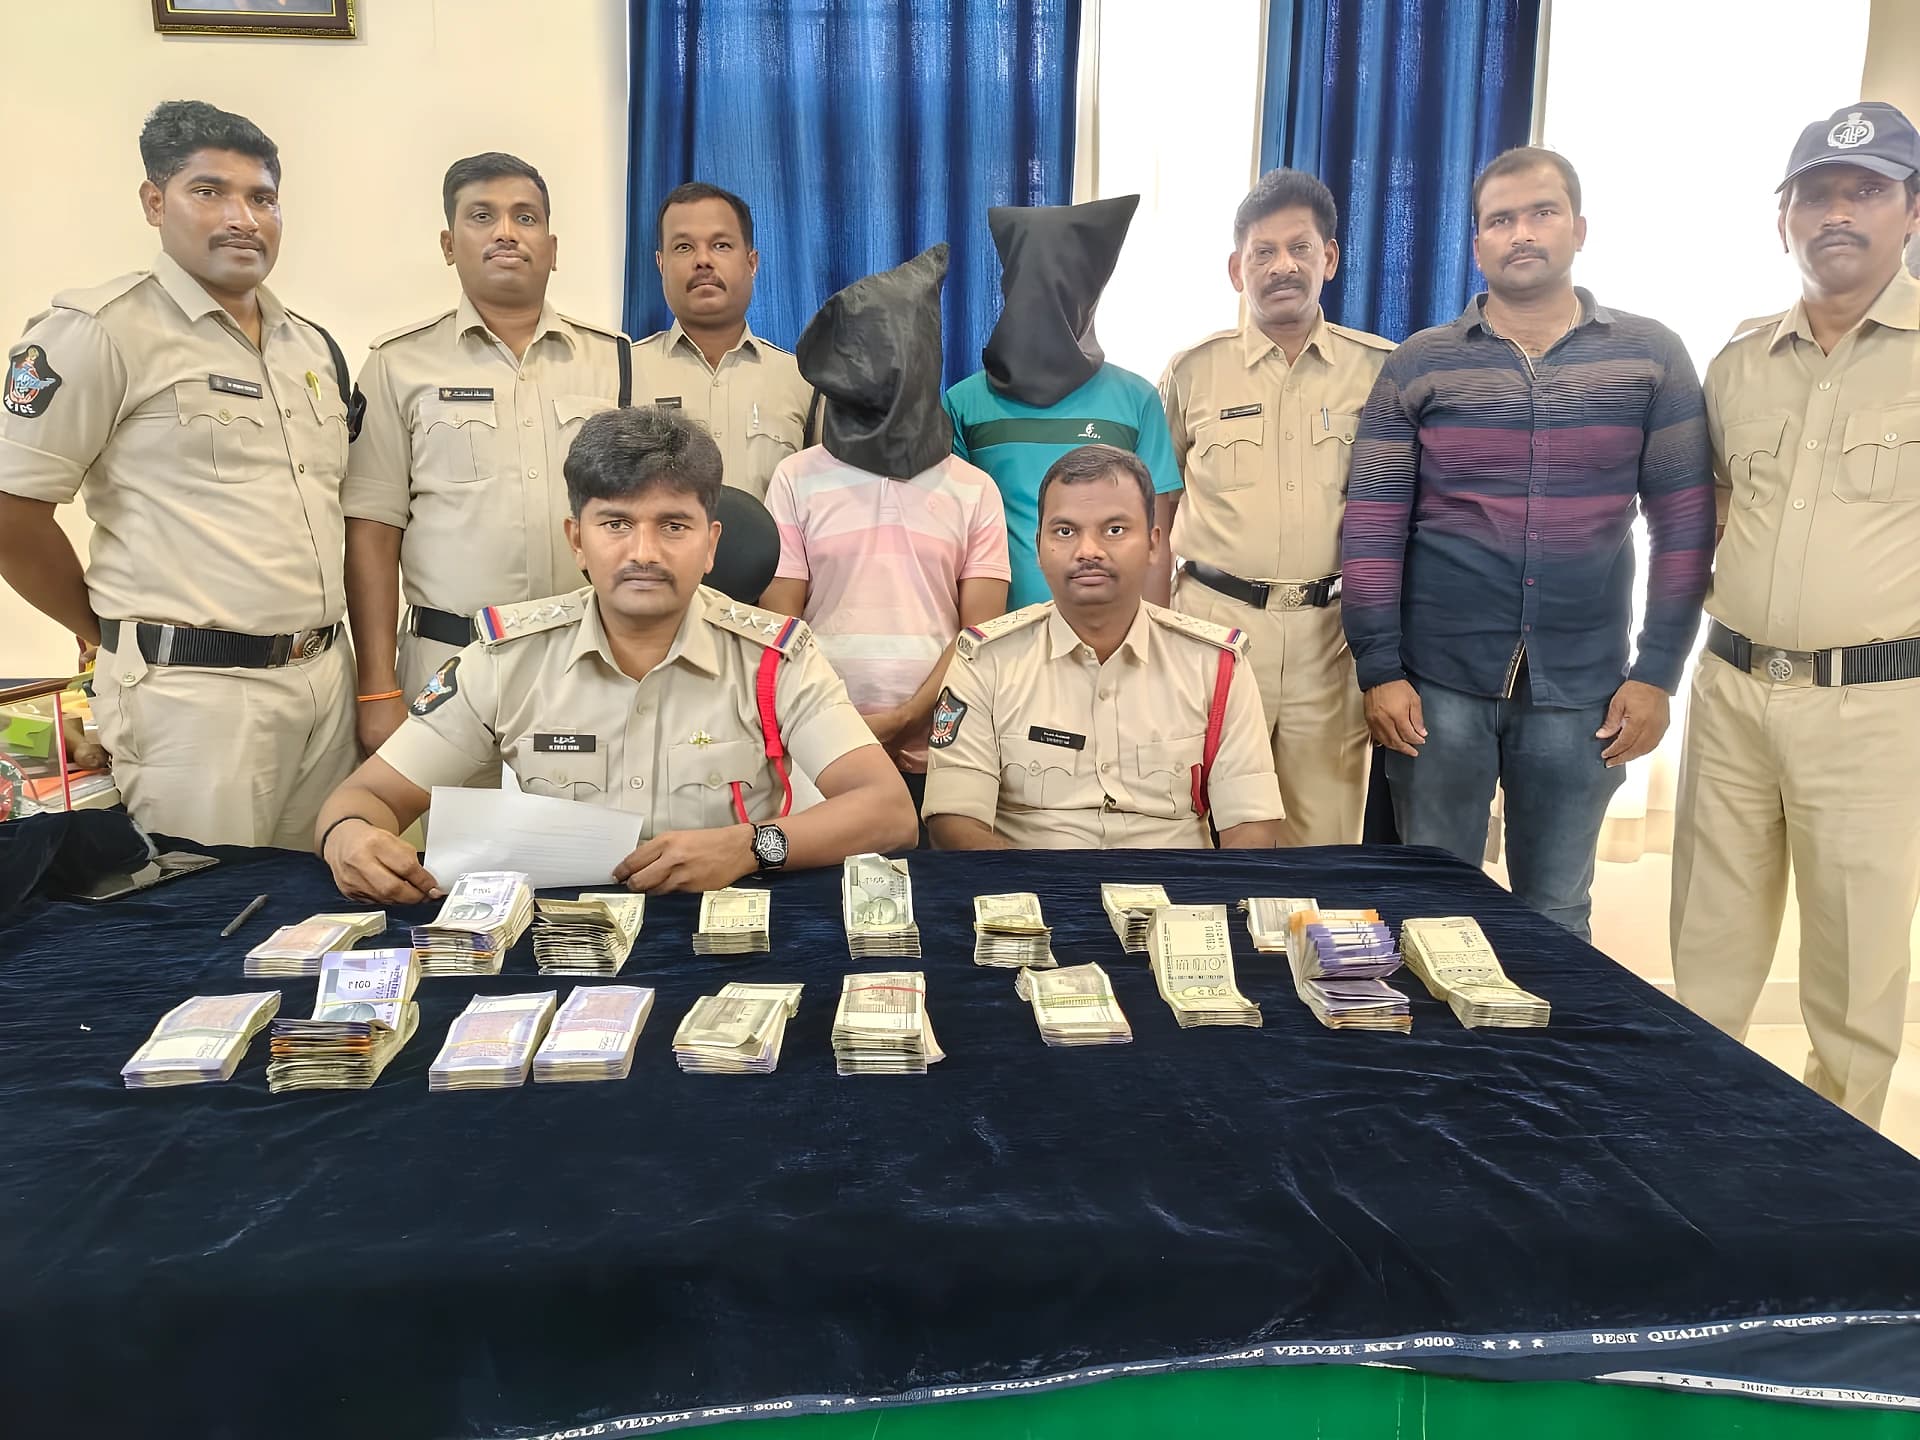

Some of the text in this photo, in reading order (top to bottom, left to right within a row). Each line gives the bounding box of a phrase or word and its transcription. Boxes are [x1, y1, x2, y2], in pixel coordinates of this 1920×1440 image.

[1591, 1333, 1640, 1345] BEST
[1647, 1324, 1733, 1343] QUALITY
[1273, 1344, 1354, 1356] VELVET
[1413, 1336, 1455, 1349] 9000
[611, 1411, 693, 1432] VELVET
[753, 1400, 793, 1412] 9000
